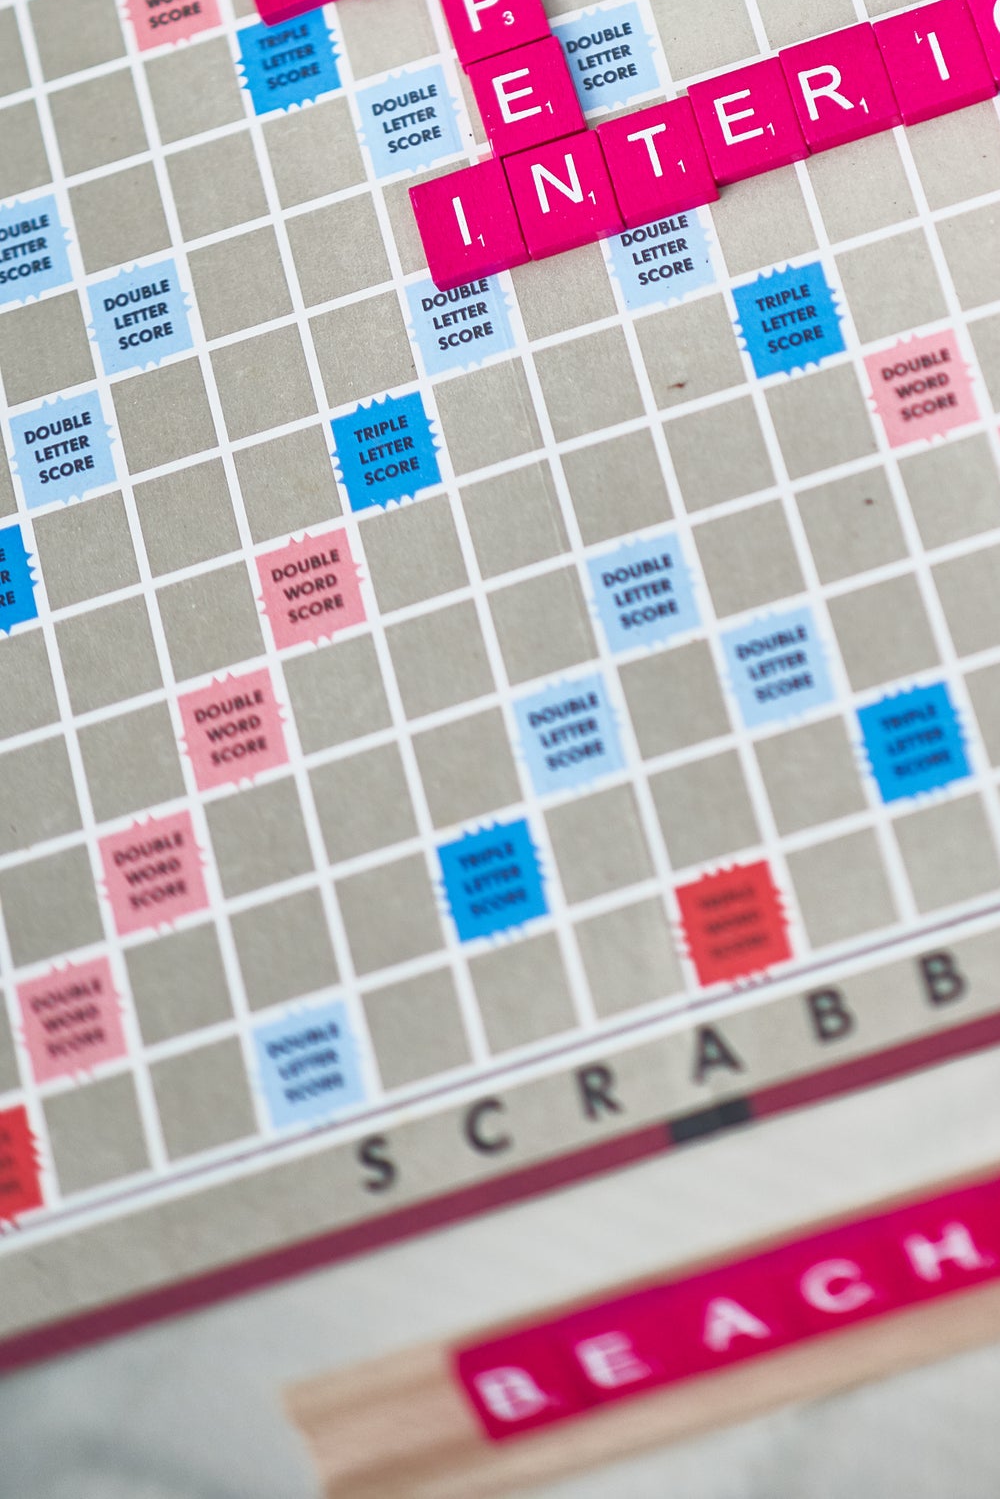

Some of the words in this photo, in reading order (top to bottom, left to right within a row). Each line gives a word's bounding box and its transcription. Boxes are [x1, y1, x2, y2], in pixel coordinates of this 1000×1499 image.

[149, 2, 201, 28] SCORE
[258, 24, 310, 50] TRIPLE
[566, 22, 633, 54] DOUBLE
[262, 44, 315, 71] LETTER
[577, 45, 633, 72] LETTER
[266, 62, 320, 90] SCORE
[583, 63, 637, 91] SCORE
[372, 85, 437, 116] DOUBLE
[383, 107, 436, 133] LETTER
[388, 126, 441, 153] SCORE
[620, 215, 688, 246] DOUBLE
[633, 238, 688, 265] LETTER
[0, 257, 51, 284] SCORE
[638, 258, 693, 285] SCORE
[104, 280, 170, 311] DOUBLE
[421, 279, 489, 311] DOUBLE
[756, 284, 810, 311] TRIPLE
[114, 303, 168, 329] LETTER
[433, 302, 488, 329] LETTER
[762, 305, 817, 333] LETTER
[119, 322, 173, 349] SCORE
[439, 322, 493, 350] SCORE
[768, 325, 824, 353] SCORE
[882, 349, 949, 381] DOUBLE
[895, 373, 949, 399] WORD
[901, 393, 956, 421] SCORE
[24, 412, 91, 444] DOUBLE
[354, 415, 408, 443] TRIPLE
[35, 435, 90, 463] LETTER
[359, 437, 414, 464] LETTER
[39, 455, 94, 483] SCORE
[365, 457, 419, 485] SCORE
[272, 549, 339, 582] DOUBLE
[603, 555, 671, 587] DOUBLE
[283, 574, 337, 600] WORD
[615, 579, 671, 607] LETTER
[288, 594, 343, 623] SCORE
[621, 600, 677, 628] SCORE
[736, 627, 808, 660] DOUBLE
[750, 652, 806, 680] LETTER
[756, 674, 812, 701] SCORE
[194, 690, 263, 723] DOUBLE
[529, 694, 598, 727] DOUBLE
[206, 716, 261, 742] WORD
[541, 718, 597, 747] LETTER
[211, 737, 266, 765] SCORE
[547, 740, 603, 769] SCORE
[114, 832, 183, 866] DOUBLE
[125, 858, 181, 885] WORD
[130, 880, 186, 909] SCORE
